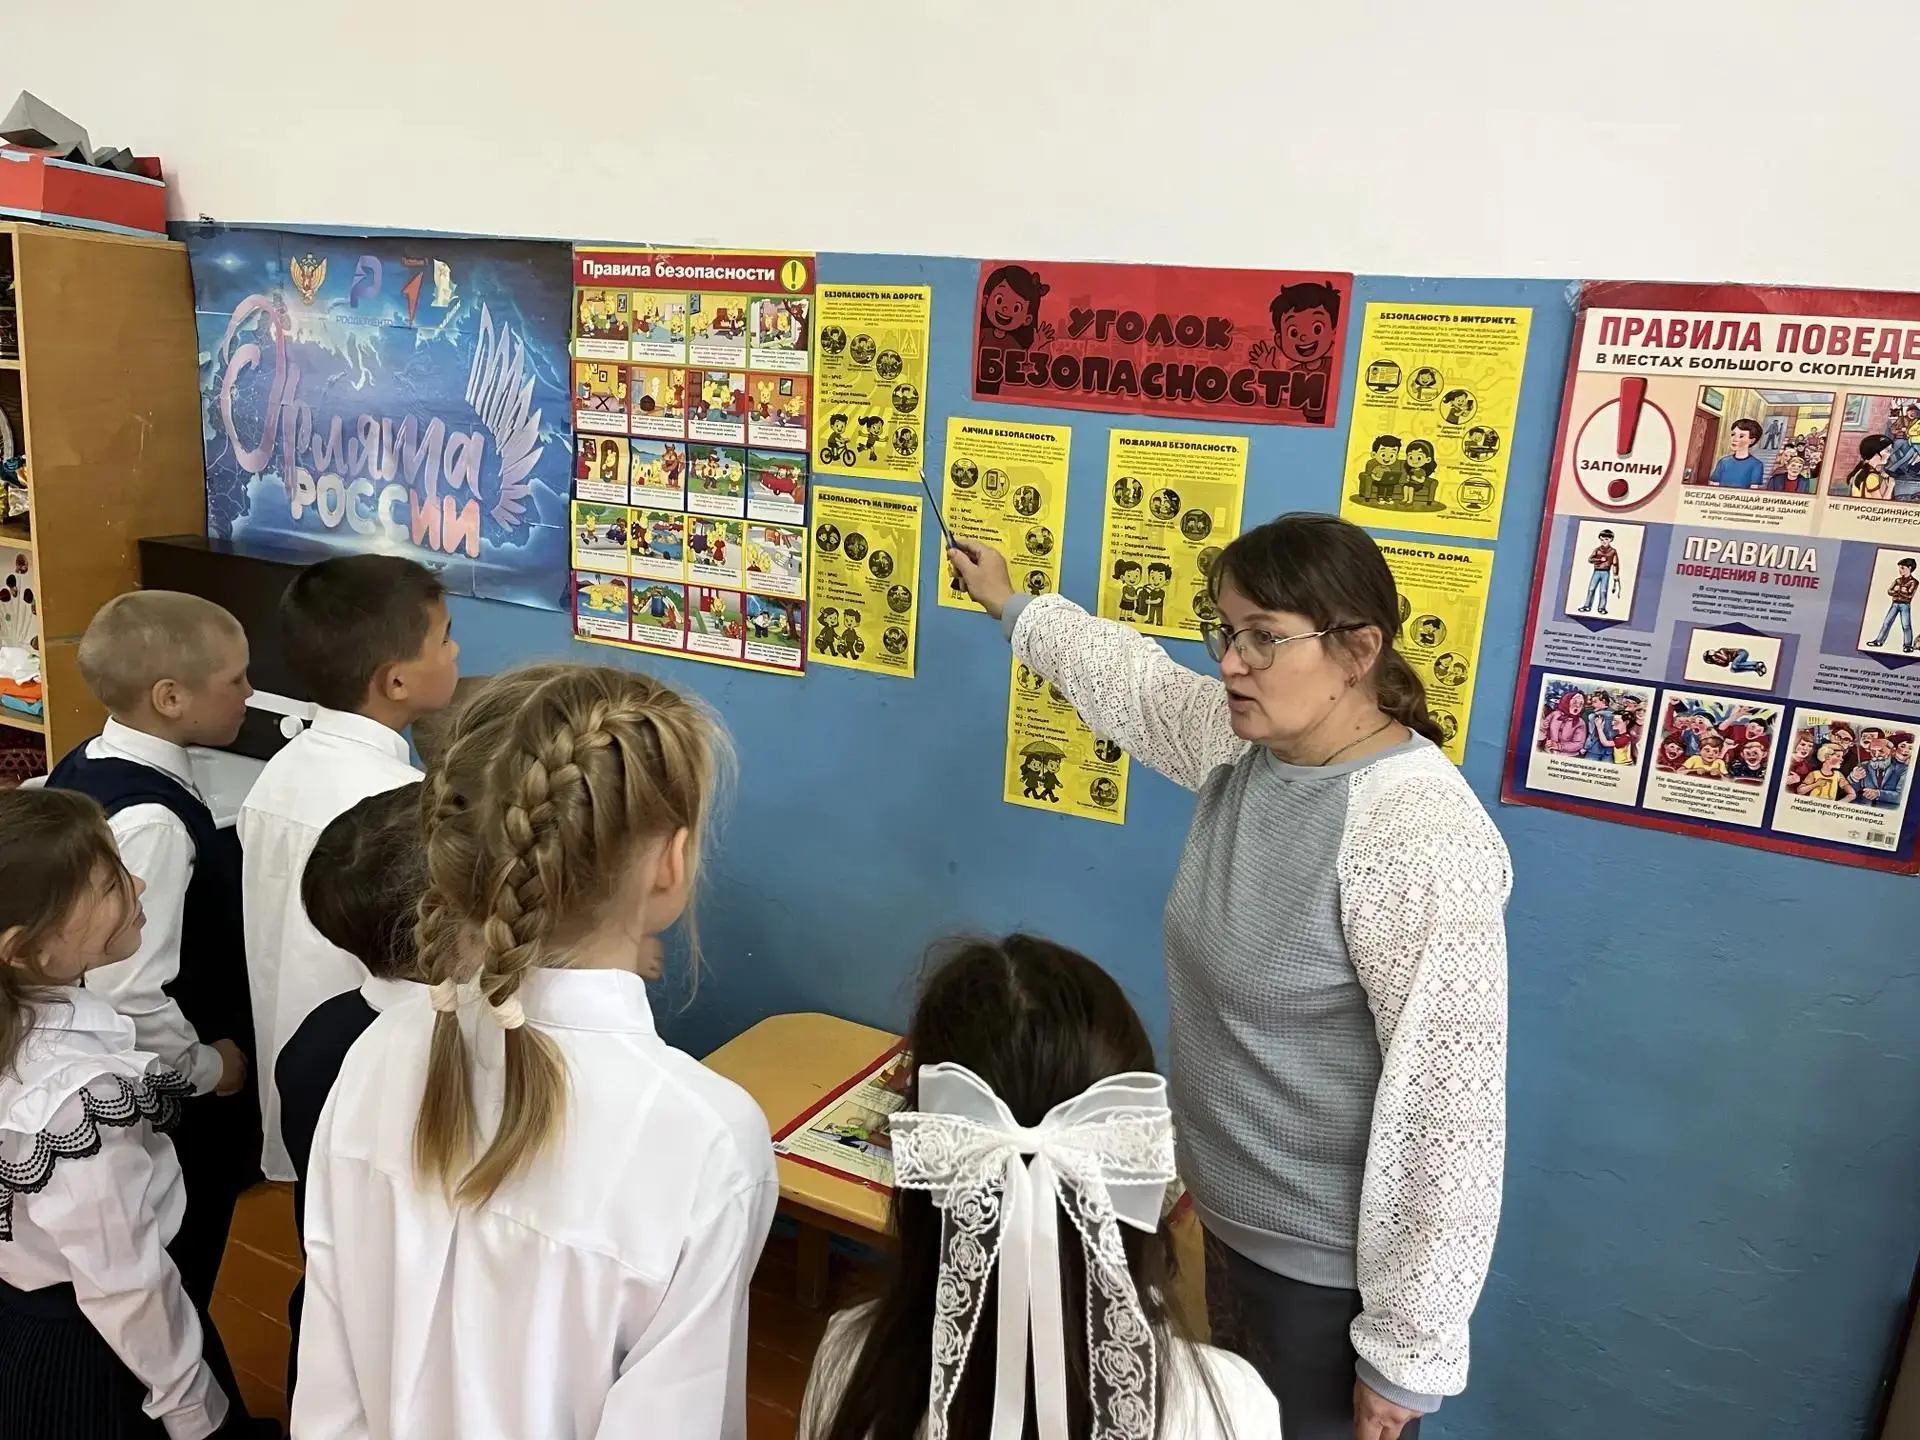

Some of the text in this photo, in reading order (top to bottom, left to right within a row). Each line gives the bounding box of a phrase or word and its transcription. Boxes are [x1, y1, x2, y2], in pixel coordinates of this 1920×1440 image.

[582, 260, 775, 281] Правила безопасности
[824, 291, 879, 299] БЕЗОПАСНОСТЬ
[1380, 312, 1450, 322] БЕЗОПАСНОСТЬ
[1067, 307, 1235, 350] УГОЛОК
[1598, 316, 1762, 352] ПРАВИЛА
[1596, 353, 1916, 381] В МЕСТАХ БОЛЬШОГО СКОПЛЕНИЯ
[980, 347, 1326, 411] БЕЗОПАСНОСТИ
[221, 294, 484, 499] Орлята
[962, 426, 994, 435] ЛИЧНАЯ
[1120, 438, 1168, 448] ПОЖАРНАЯ
[1581, 459, 1663, 476] ЗАПОМНИ
[818, 493, 872, 506] БЕЗОПАСНОСТЬ
[883, 502, 918, 512] ПРИРОДЕ
[1685, 491, 1809, 507] ВСЕГДА ОБРАЩАЙ ВНИМАНИЕ
[291, 467, 480, 558] РОССИИ
[1723, 502, 1764, 511] ЭВАКУАЦИИ
[1776, 507, 1807, 515] ЗДАНИЯ
[1843, 504, 1920, 517] ПРИСОЕДИНЯЙСЯ
[962, 516, 984, 524] Полиция
[1856, 514, 1881, 522] «РАДИ
[959, 532, 979, 540] Служба
[1122, 550, 1144, 558] Служба
[1683, 536, 1817, 573] ПРАВИЛА
[1676, 563, 1820, 589] ПОВЕДЕНИЯ В ТОЛПЕ
[1819, 664, 1848, 672] Скрести
[1860, 669, 1880, 677] груди
[1840, 674, 1870, 682] немного
[1814, 678, 1848, 687] защитить
[1849, 684, 1880, 692] грудную
[1881, 688, 1905, 696] клетку
[1813, 686, 1860, 696] возможность
[1861, 692, 1901, 702] нормально
[1027, 716, 1049, 724] Полиция
[1027, 723, 1045, 732] Скорая
[1024, 731, 1069, 743] Служба спасения
[1581, 771, 1621, 782] агрессивно
[1668, 784, 1694, 794] поводу
[1661, 796, 1712, 808] противоречит
[1670, 791, 1706, 801] особенно
[1791, 805, 1816, 814] людей
[1817, 809, 1853, 820] пропусти
[1794, 797, 1885, 818] Наиболее беспокойных
